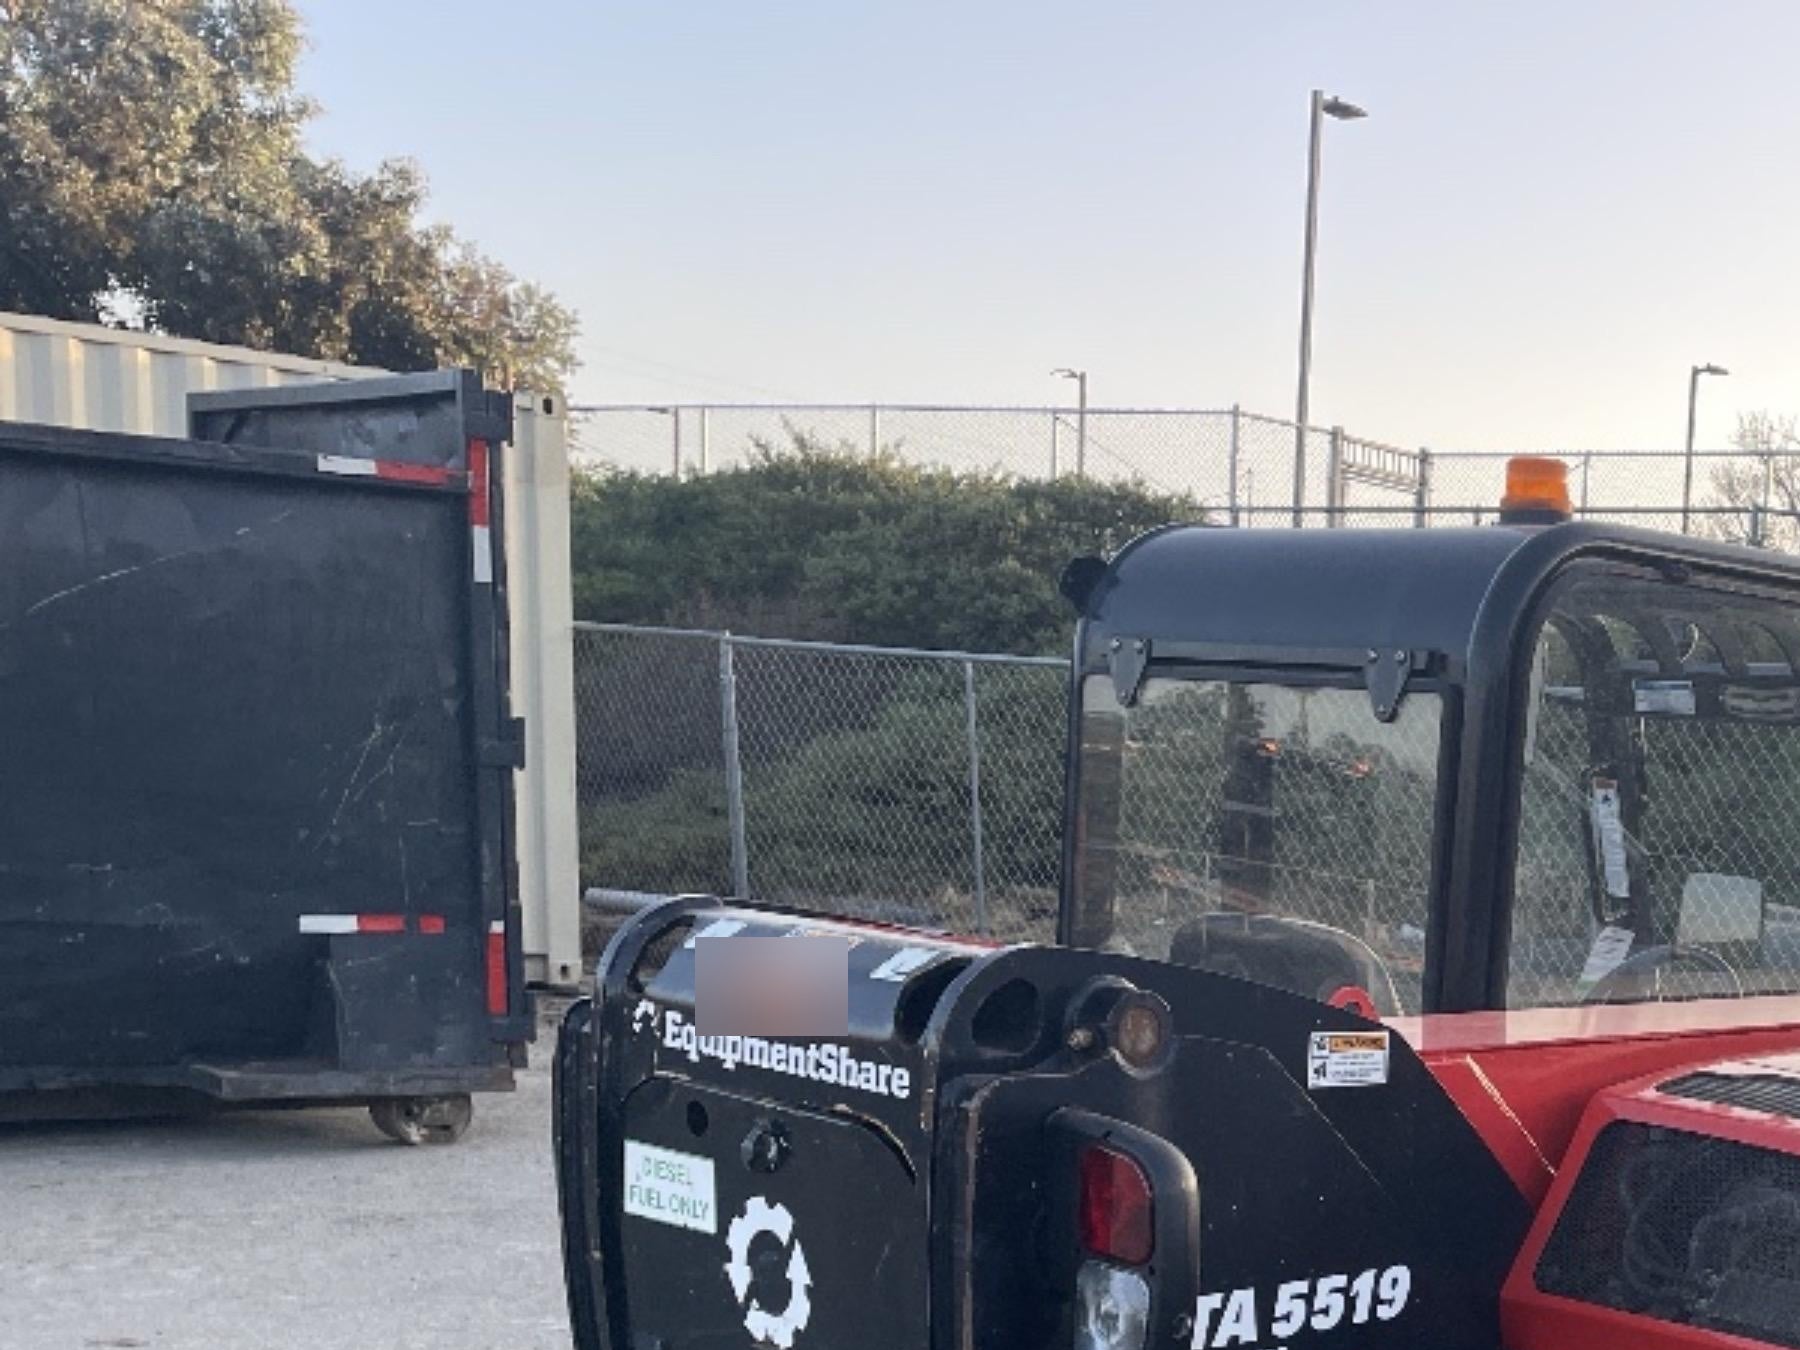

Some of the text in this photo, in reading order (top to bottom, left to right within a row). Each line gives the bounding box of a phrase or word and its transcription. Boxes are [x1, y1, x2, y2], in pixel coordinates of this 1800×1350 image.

[640, 1154, 694, 1187] DIESEL
[629, 1183, 710, 1221] FUEL ONLY
[1271, 1264, 1412, 1340] 5519
